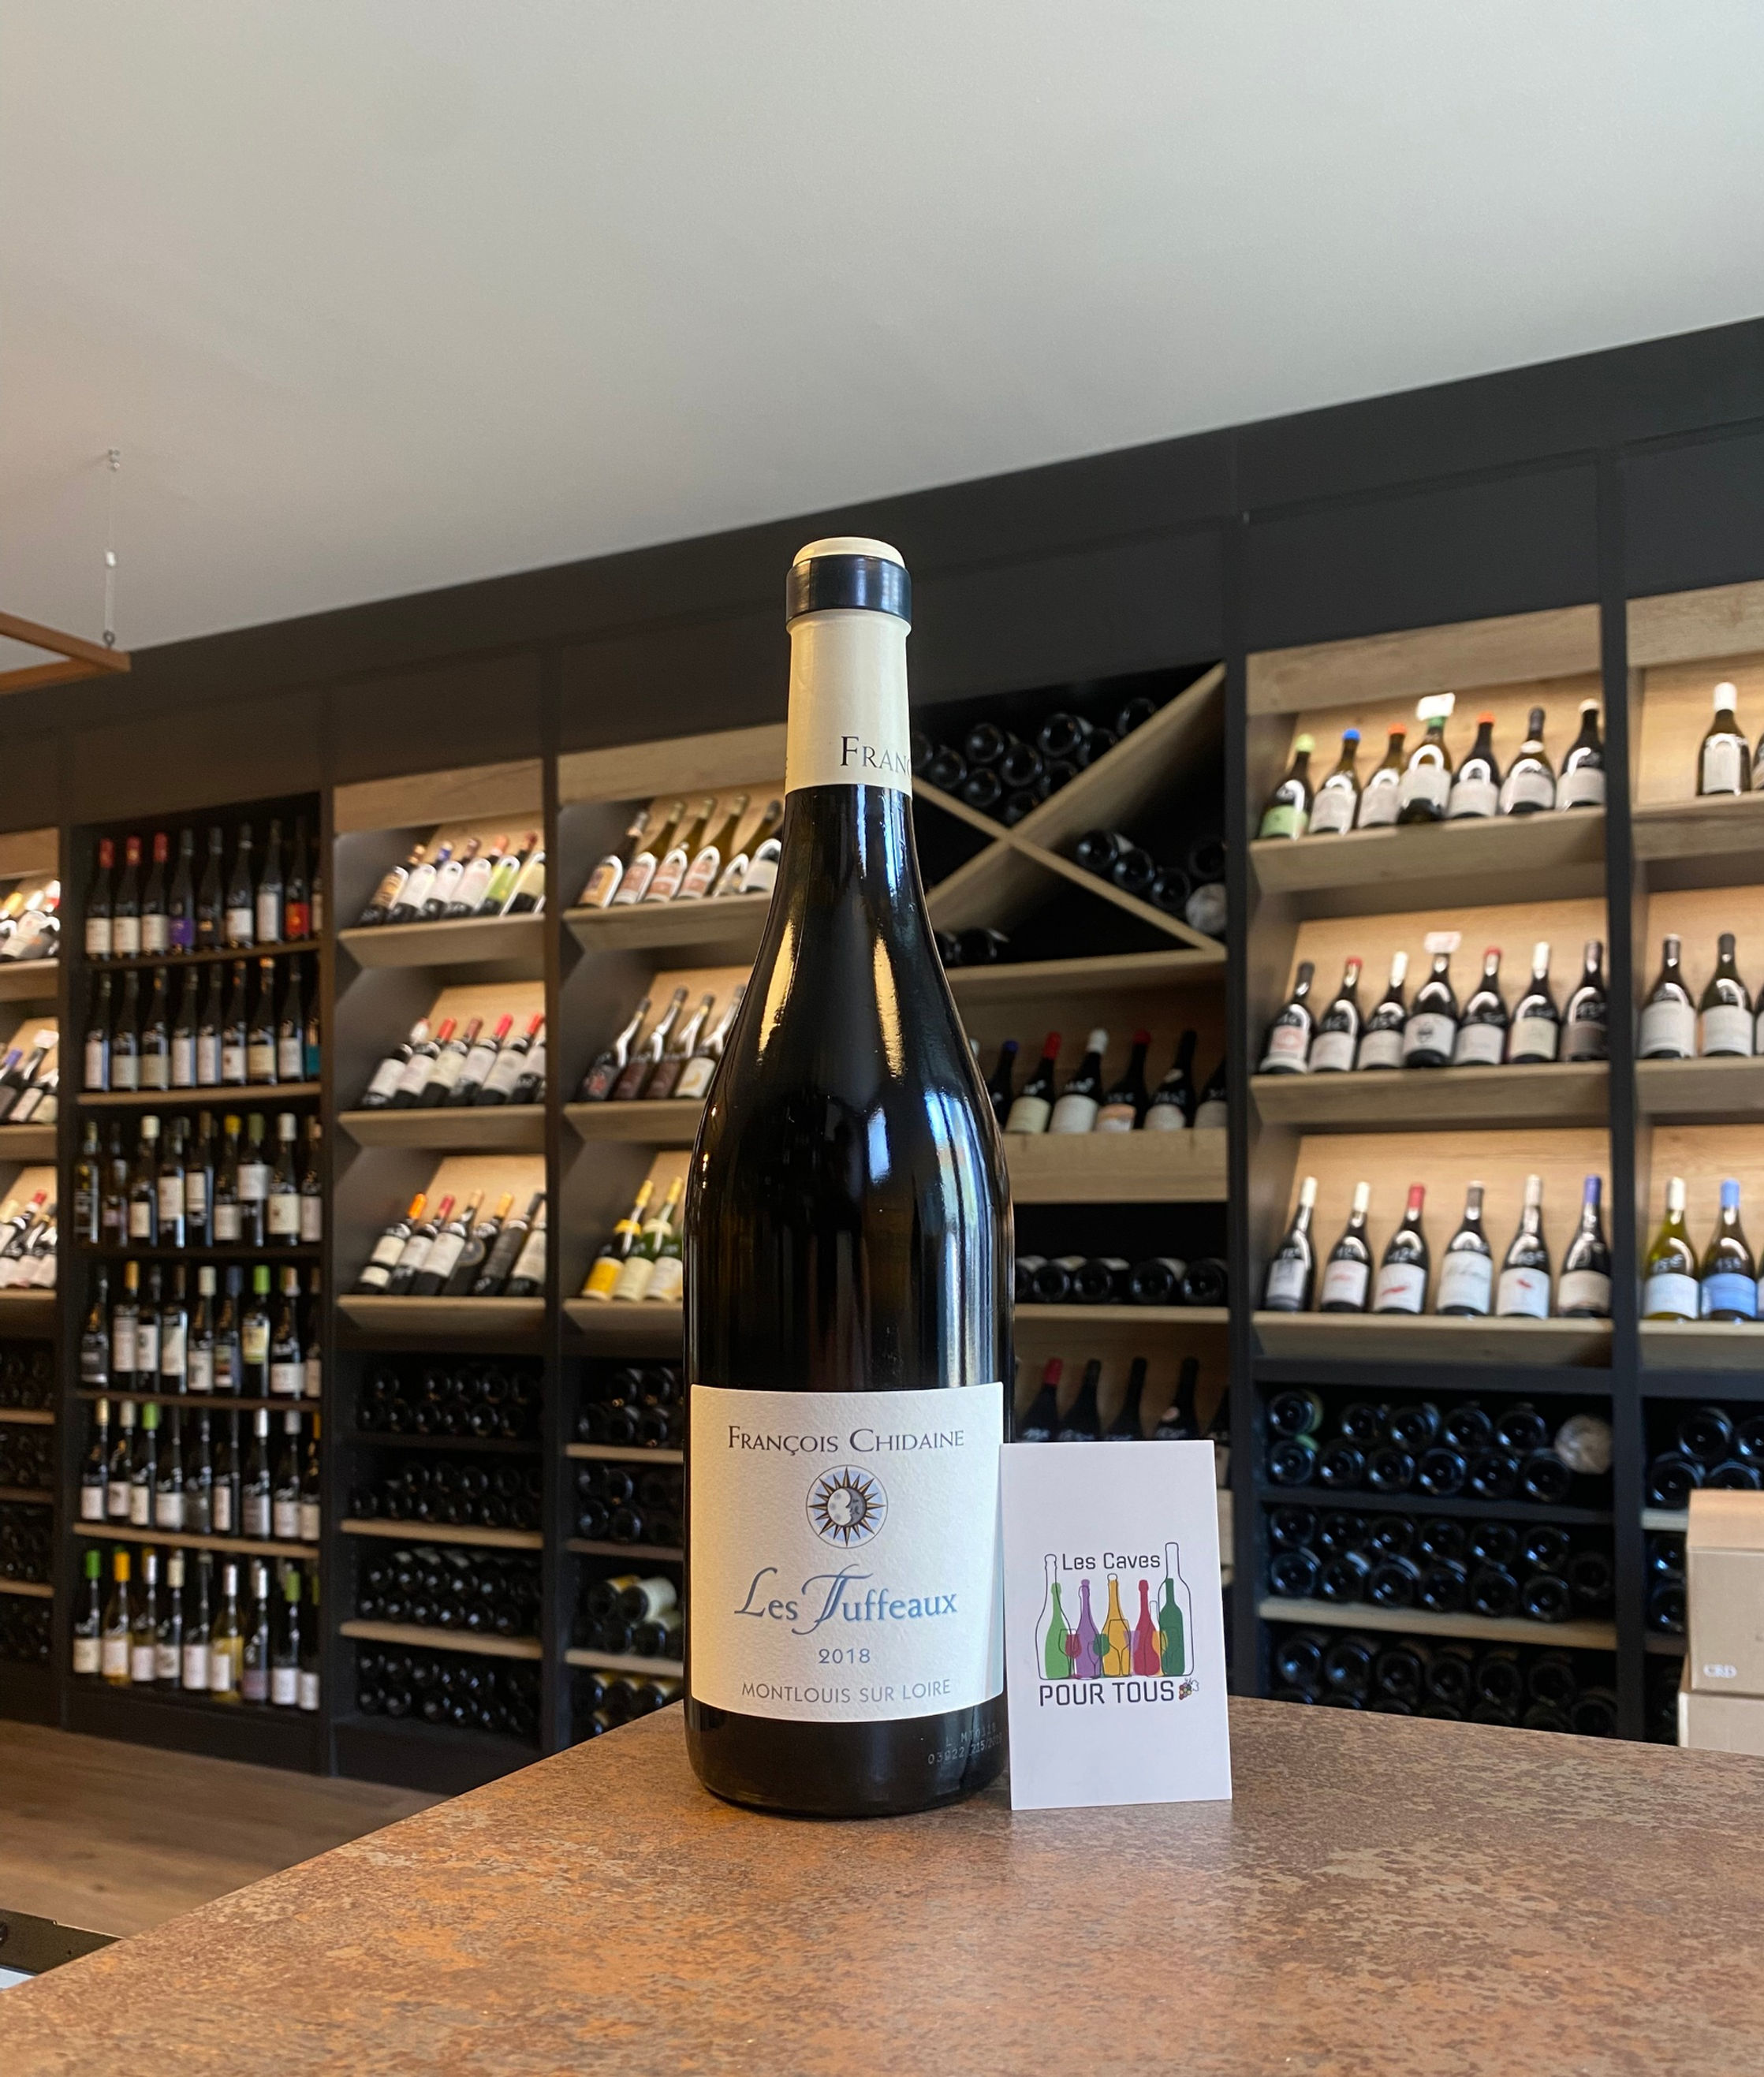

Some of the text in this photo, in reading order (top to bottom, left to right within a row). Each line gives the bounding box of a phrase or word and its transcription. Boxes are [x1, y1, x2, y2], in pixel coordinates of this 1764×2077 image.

[728, 1426, 965, 1456] FRANÇOIS CHIDAINE
[1062, 1552, 1161, 1571] Les Caves
[734, 1564, 957, 1635] Les Tuffeaux
[819, 1648, 871, 1665] 2018
[741, 1679, 951, 1704] MONTLOUIS SUR LOIRE
[1039, 1680, 1175, 1707] POUR TOUS
